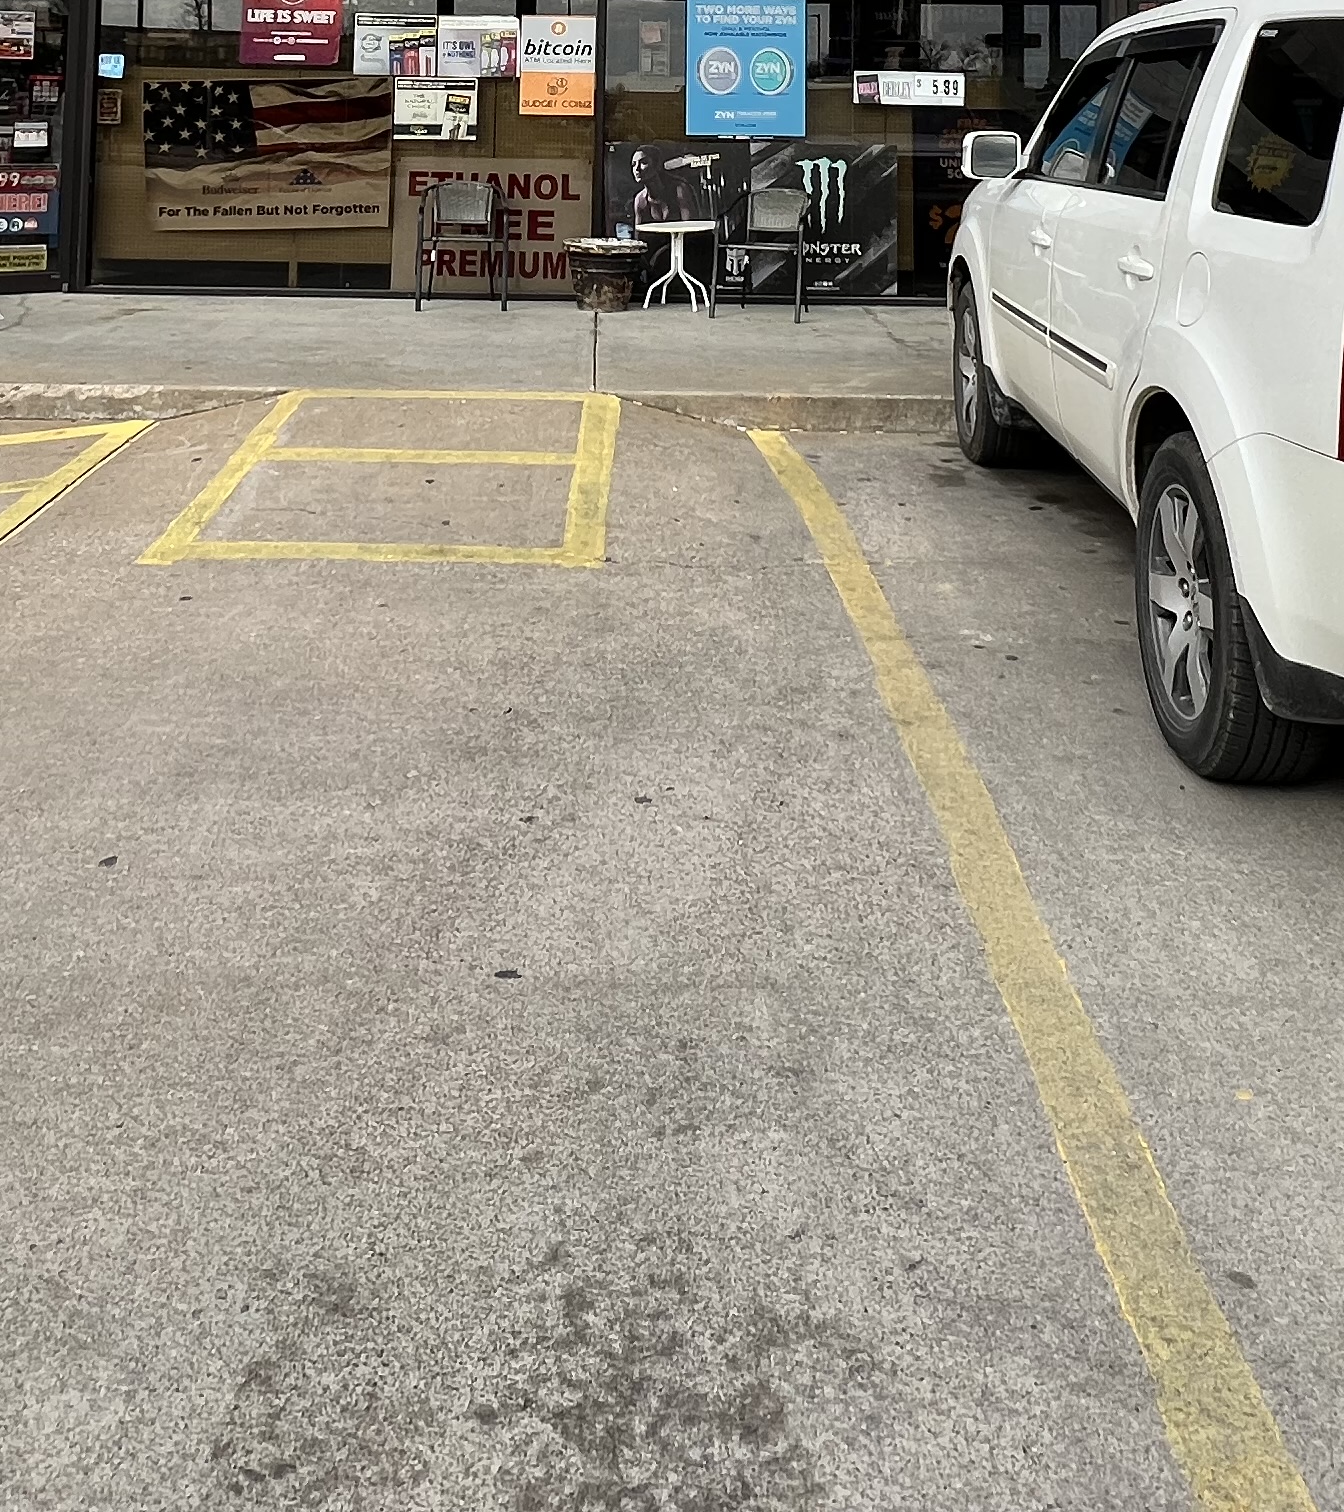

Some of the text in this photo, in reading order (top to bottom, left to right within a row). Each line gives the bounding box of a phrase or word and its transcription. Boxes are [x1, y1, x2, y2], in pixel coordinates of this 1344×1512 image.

[247, 8, 337, 25] LIFE IS SWEET
[695, 5, 797, 16] TWO MORE WAYS
[695, 15, 797, 25] TO FIND YOUR ZYN
[524, 38, 593, 56] bitcoin
[708, 61, 735, 74] ZYN
[754, 61, 781, 74] ZYN
[521, 99, 593, 109] BUDGET COINZ
[714, 110, 735, 120] ZYN
[158, 203, 380, 218] For The Fallen But Not Forgotten
[430, 208, 555, 242] EE
[791, 240, 862, 256] ONSTER
